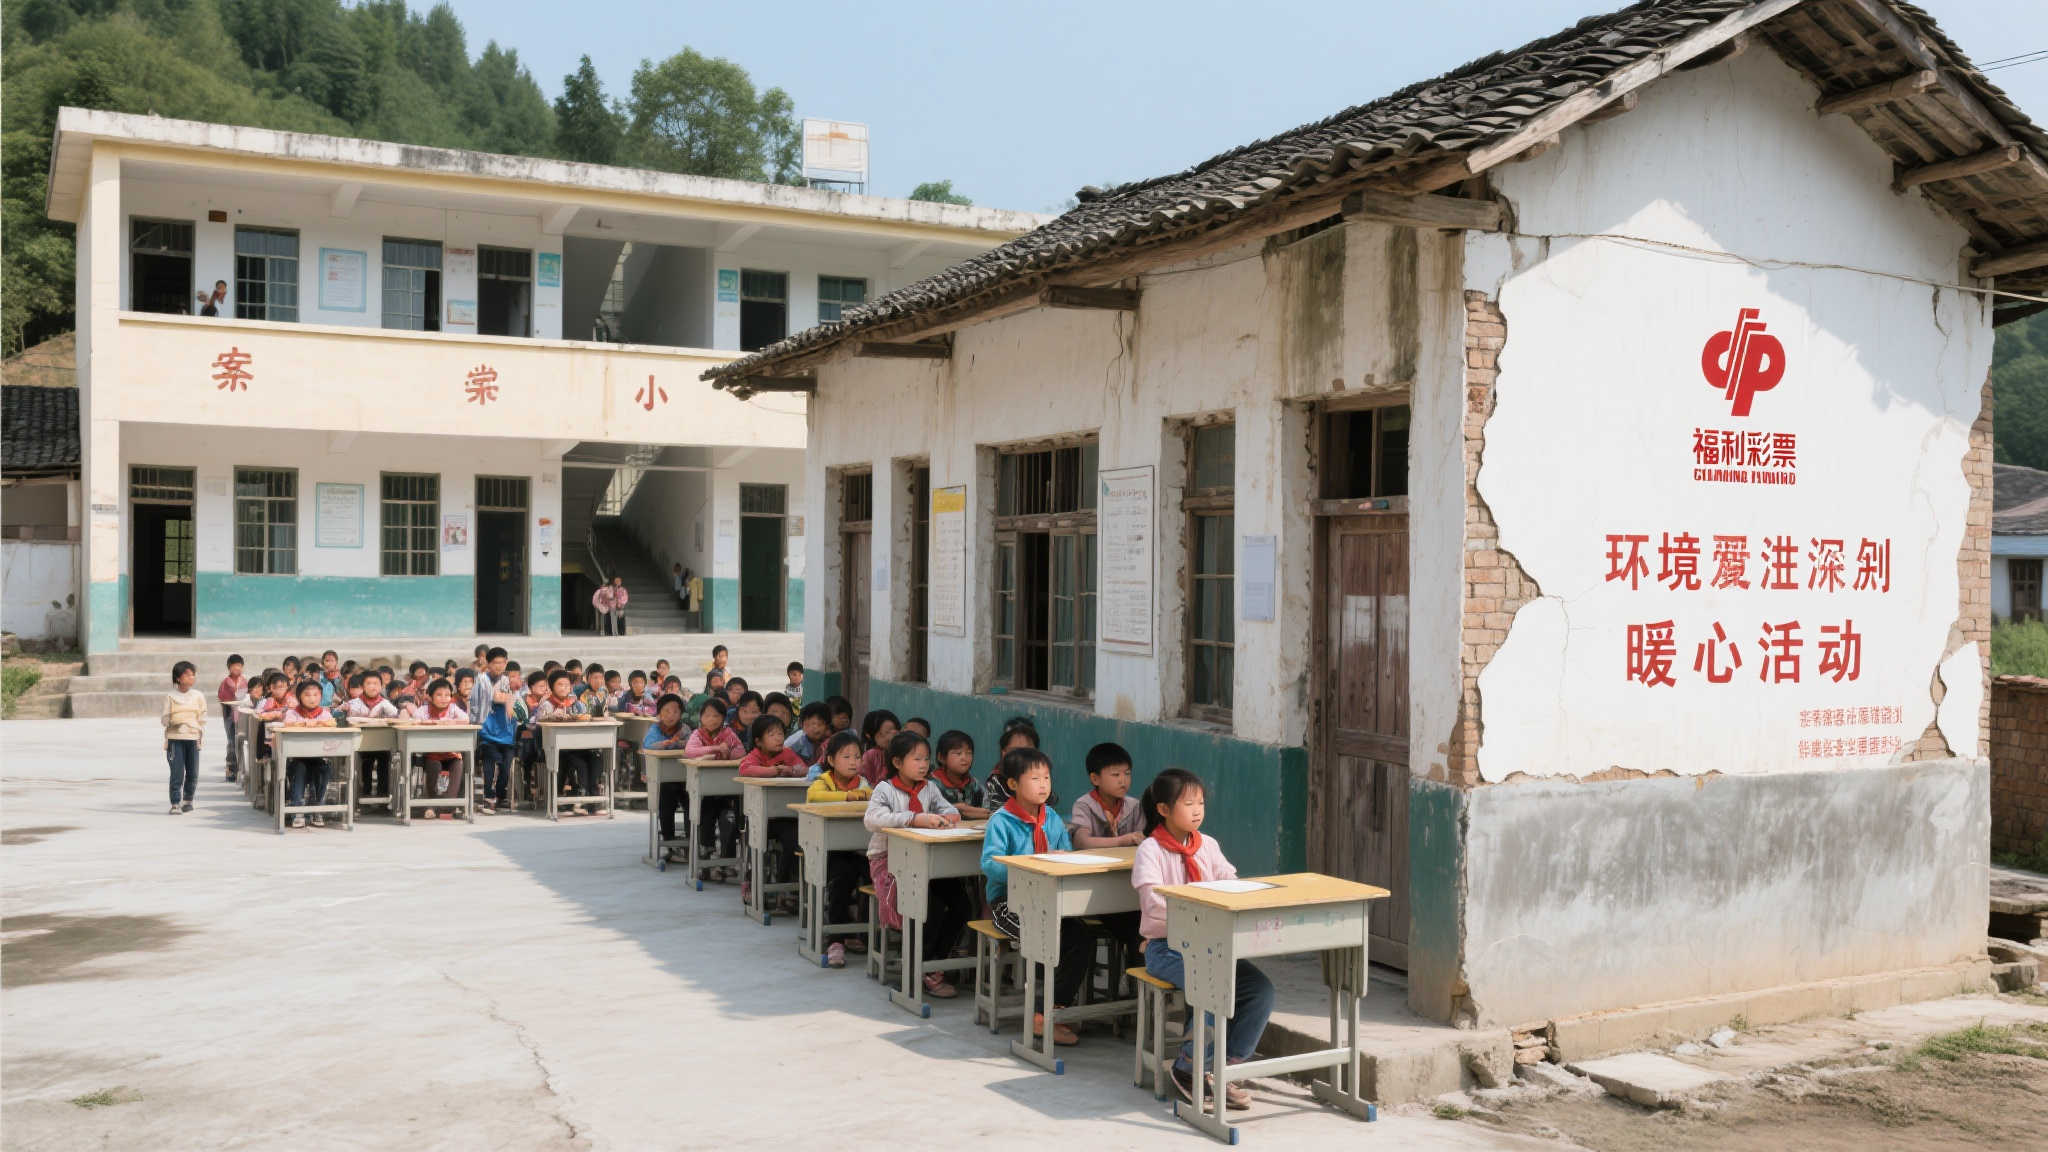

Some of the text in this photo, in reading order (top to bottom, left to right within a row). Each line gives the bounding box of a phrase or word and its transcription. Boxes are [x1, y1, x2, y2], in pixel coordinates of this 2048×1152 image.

[635, 374, 669, 412] 小
[1692, 427, 1797, 469] 福利彩票
[1626, 618, 1862, 688] 暖心活动
